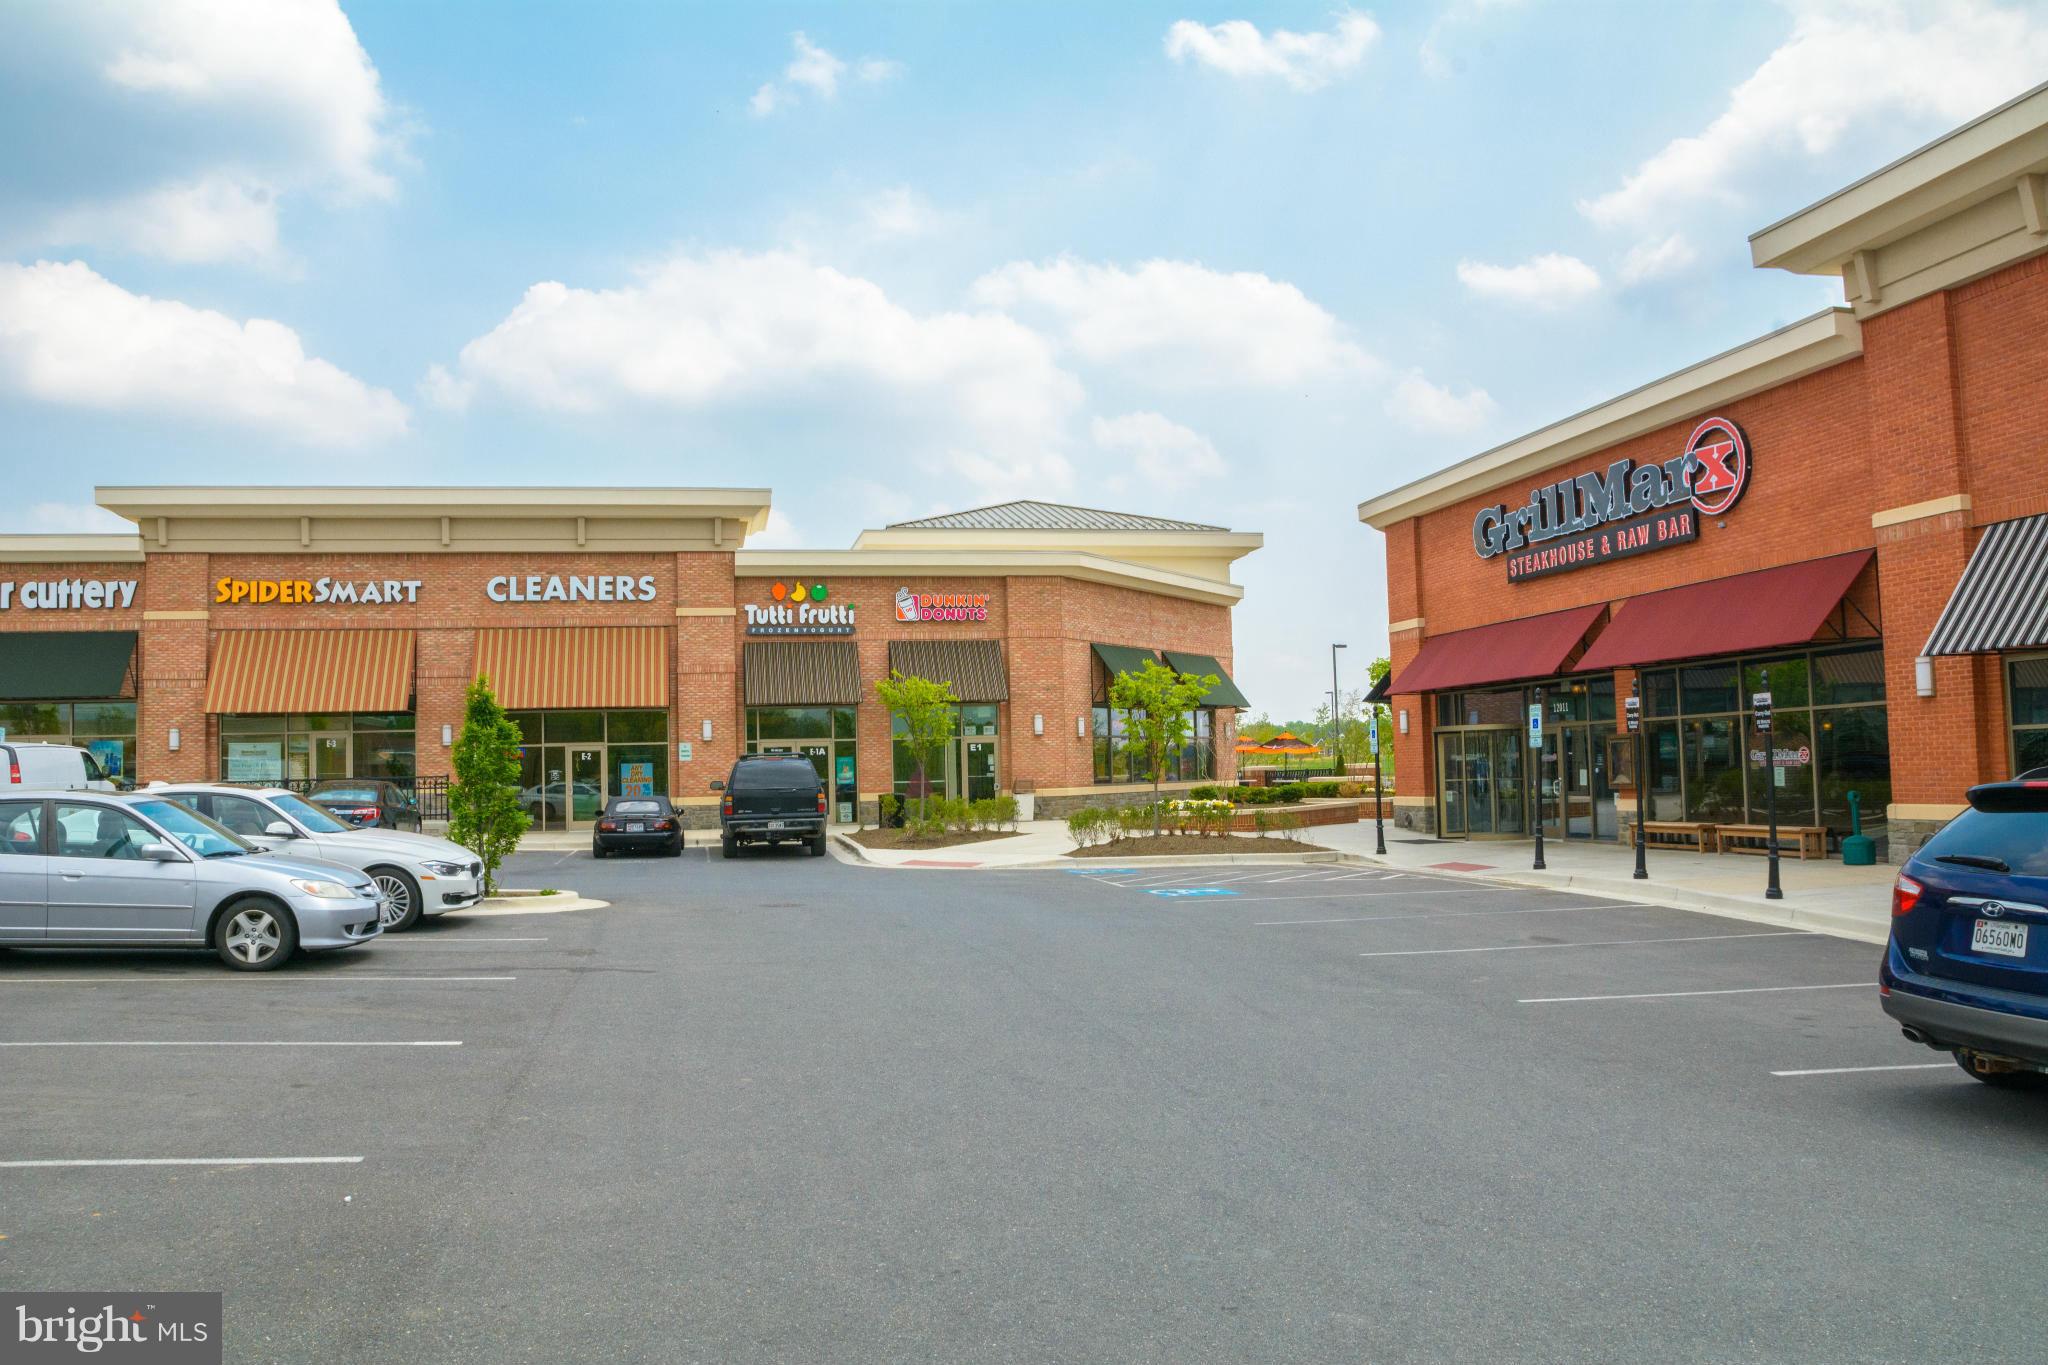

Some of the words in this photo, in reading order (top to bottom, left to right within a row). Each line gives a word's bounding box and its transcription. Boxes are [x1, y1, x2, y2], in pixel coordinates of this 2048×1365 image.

[1508, 538, 1595, 578] STEAKHOUSE
[1601, 535, 1611, 556] &
[1617, 523, 1651, 550] RAW
[1658, 513, 1692, 542] BAR
[20, 578, 138, 609] cuttery
[486, 576, 657, 602] CLEANERS
[920, 593, 990, 607] DUNKIN'
[744, 602, 793, 625] Tutti
[920, 607, 987, 621] DONUTS
[1553, 702, 1569, 713] 12011
[581, 752, 592, 761] E-2
